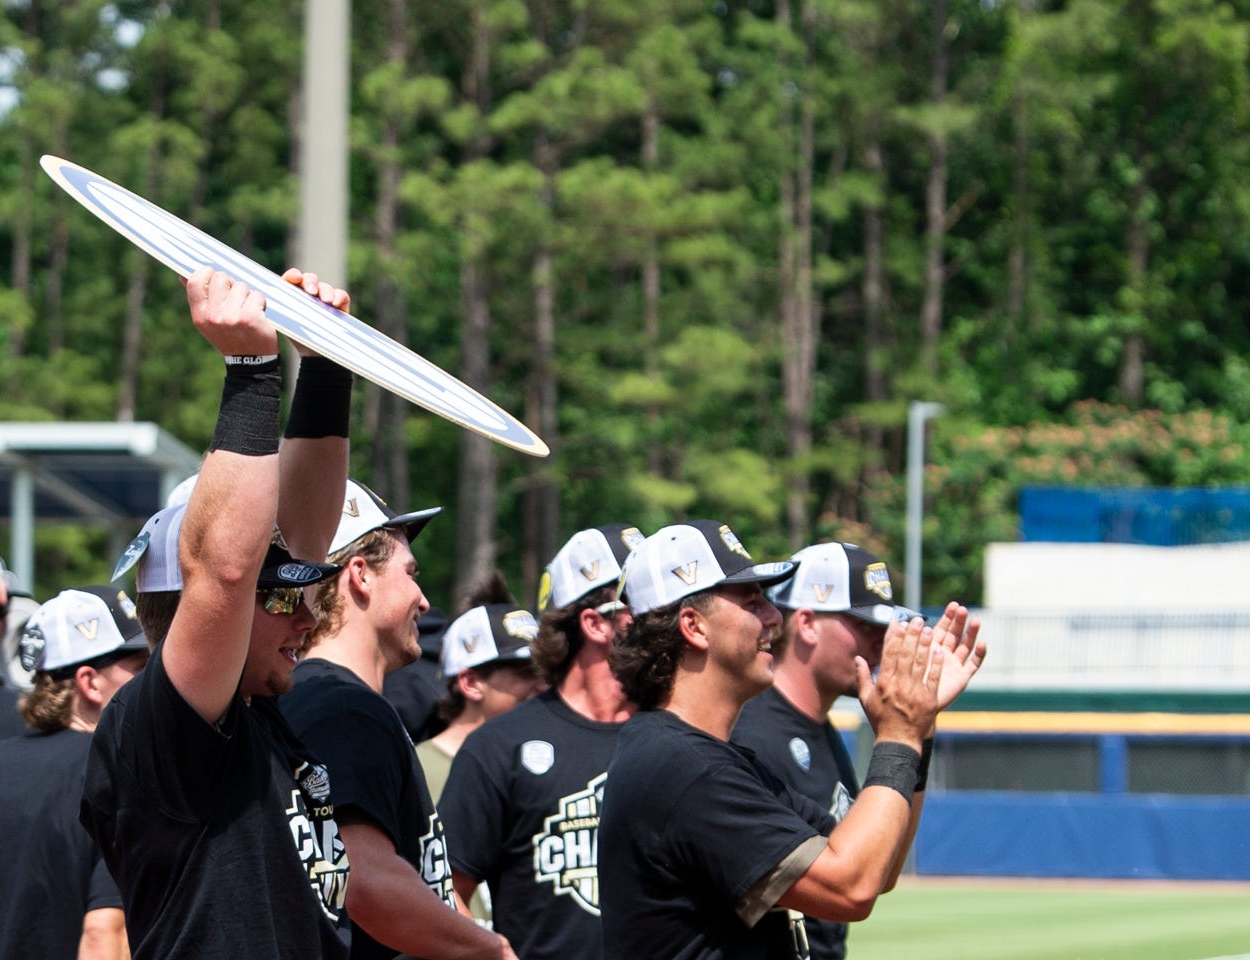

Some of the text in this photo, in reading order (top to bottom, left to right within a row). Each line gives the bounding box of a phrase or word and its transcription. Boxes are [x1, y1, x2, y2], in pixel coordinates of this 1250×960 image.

[580, 560, 600, 580] V
[671, 560, 698, 585] V
[813, 584, 834, 602] V
[74, 619, 99, 640] V
